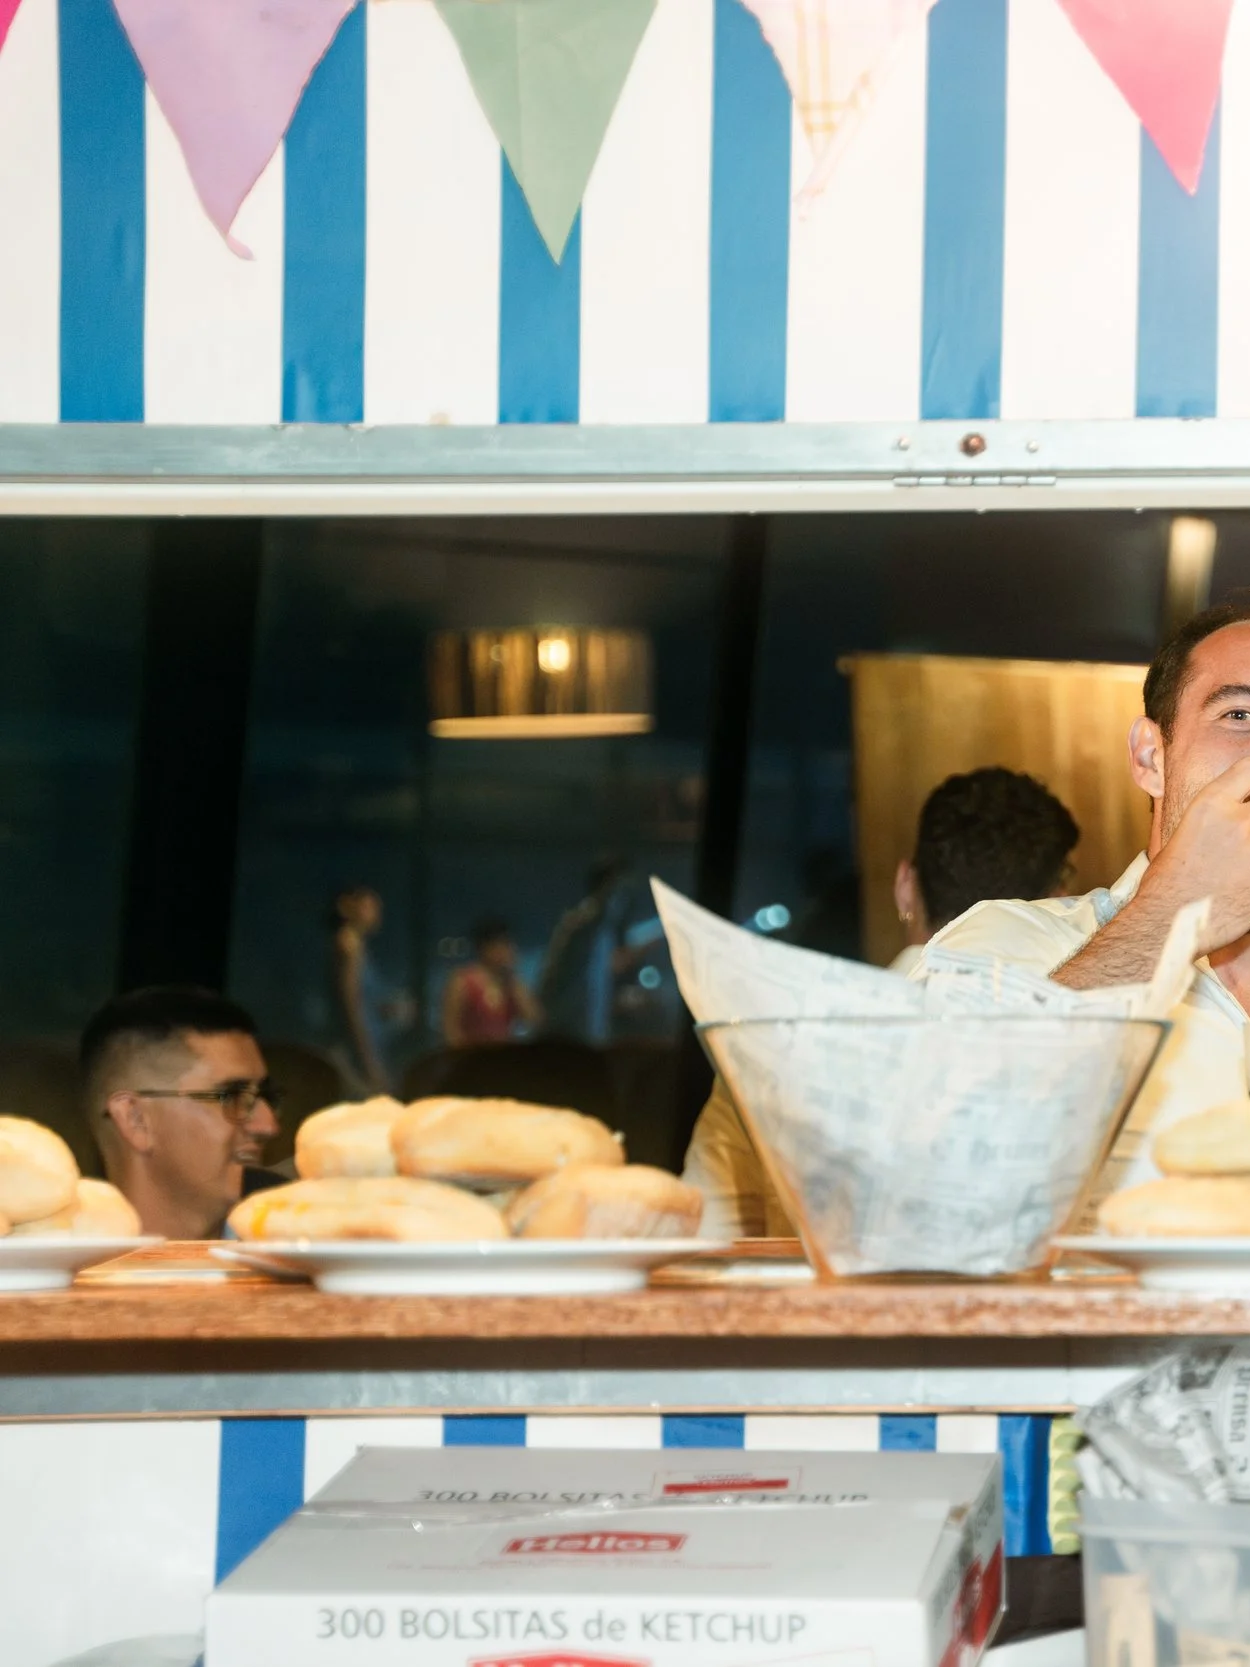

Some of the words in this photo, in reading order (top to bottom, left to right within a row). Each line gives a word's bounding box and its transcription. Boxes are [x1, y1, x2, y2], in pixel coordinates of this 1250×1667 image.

[517, 1536, 672, 1551] Helios
[316, 1608, 385, 1640] 300
[400, 1608, 569, 1641] BOLSITAS
[582, 1609, 627, 1641] de
[640, 1611, 806, 1644] KETCHUP
